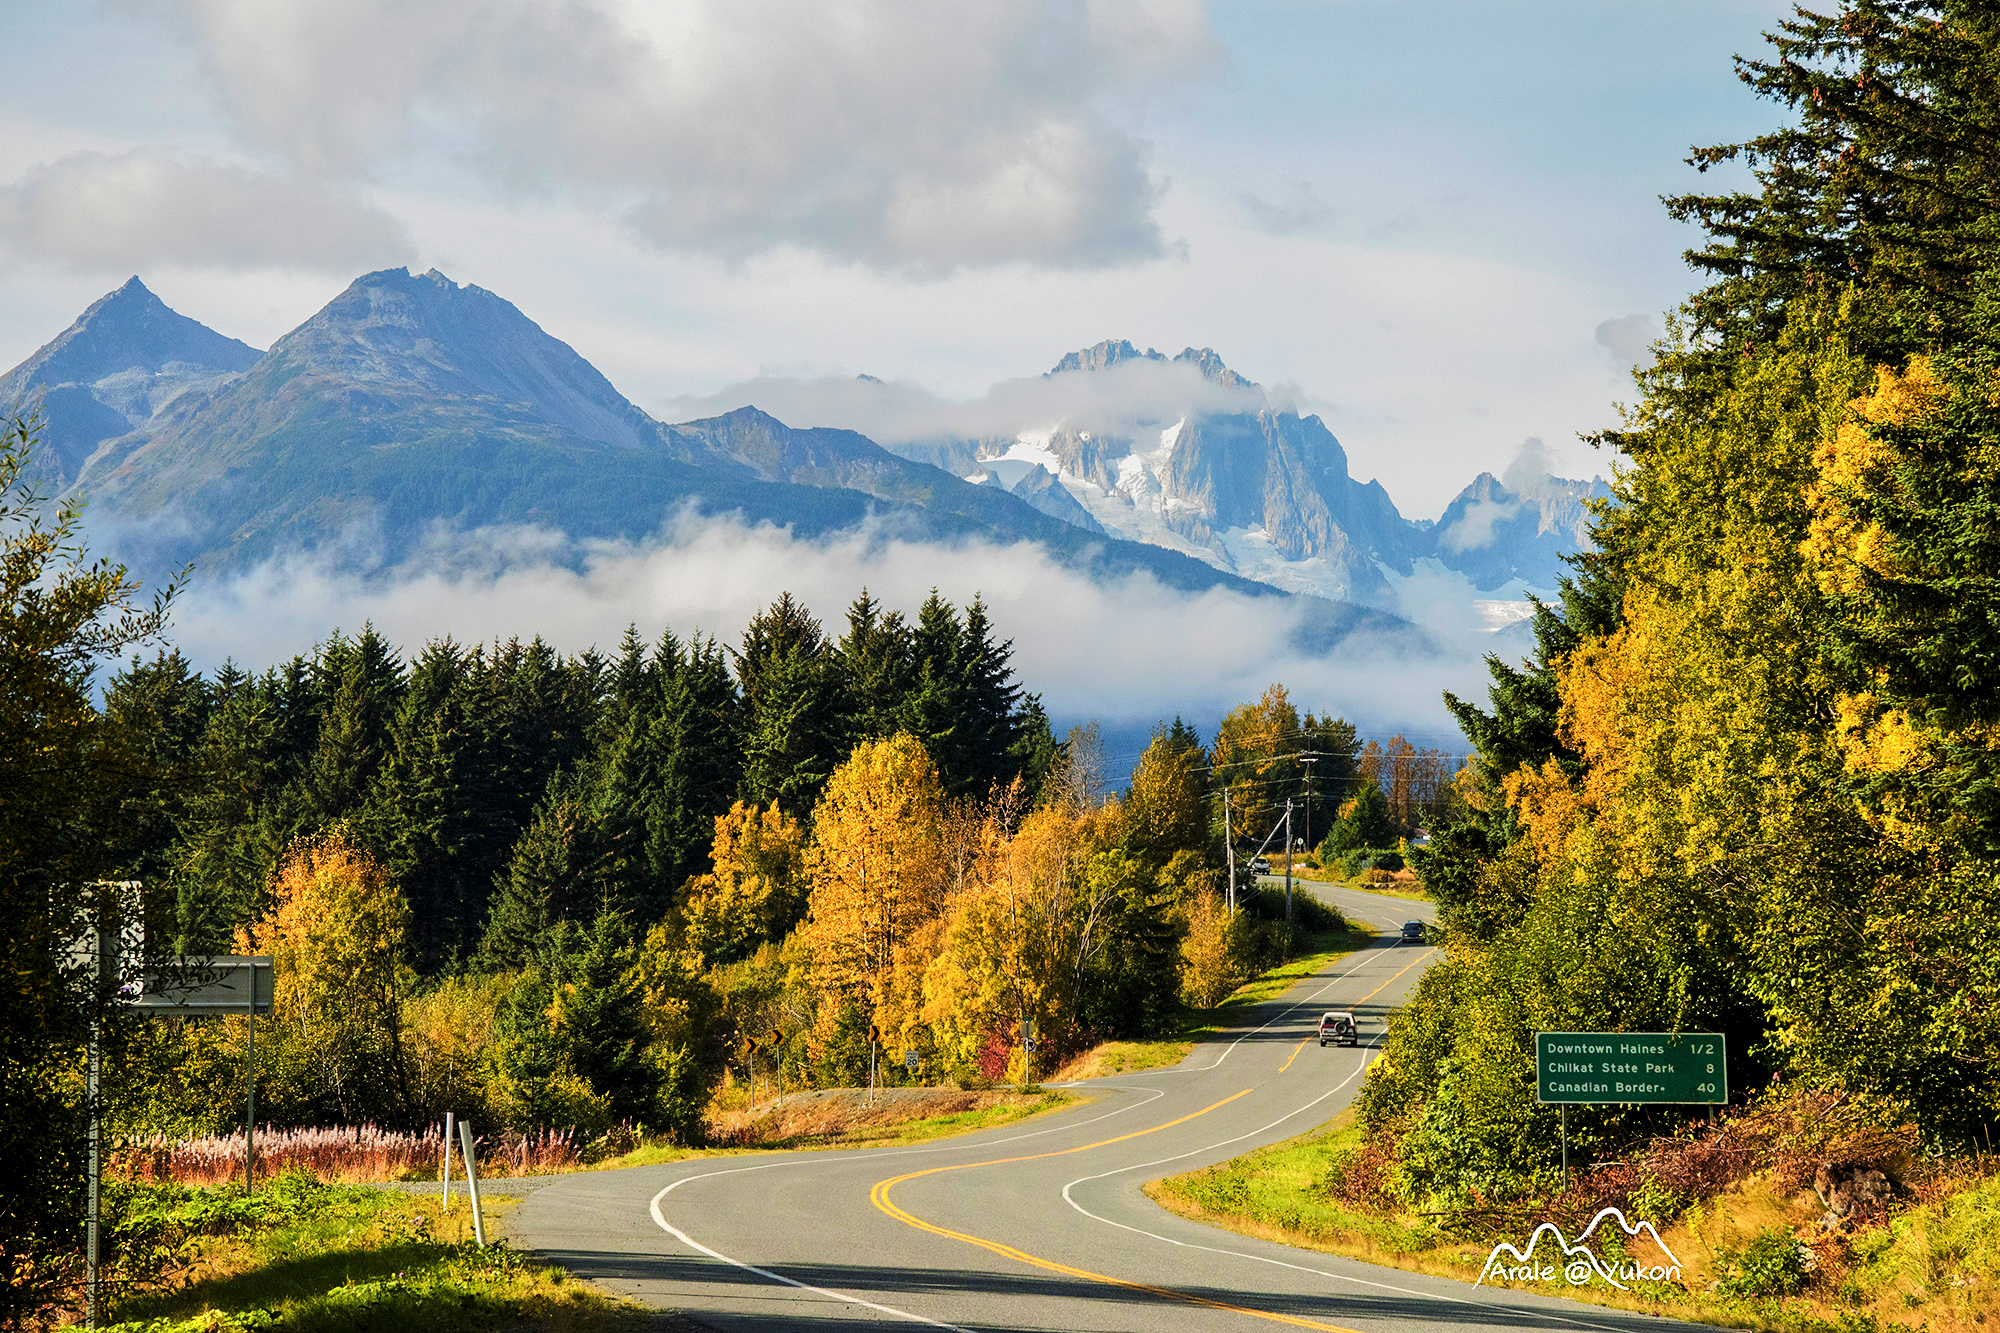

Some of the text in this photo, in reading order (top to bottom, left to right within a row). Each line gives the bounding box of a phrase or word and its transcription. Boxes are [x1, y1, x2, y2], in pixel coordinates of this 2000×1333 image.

[1547, 1043, 1714, 1055] Downtown Haines 1/2
[1548, 1062, 1715, 1074] Chilkat State Park 8
[1549, 1082, 1609, 1092] Canadian
[1696, 1083, 1716, 1093] 40
